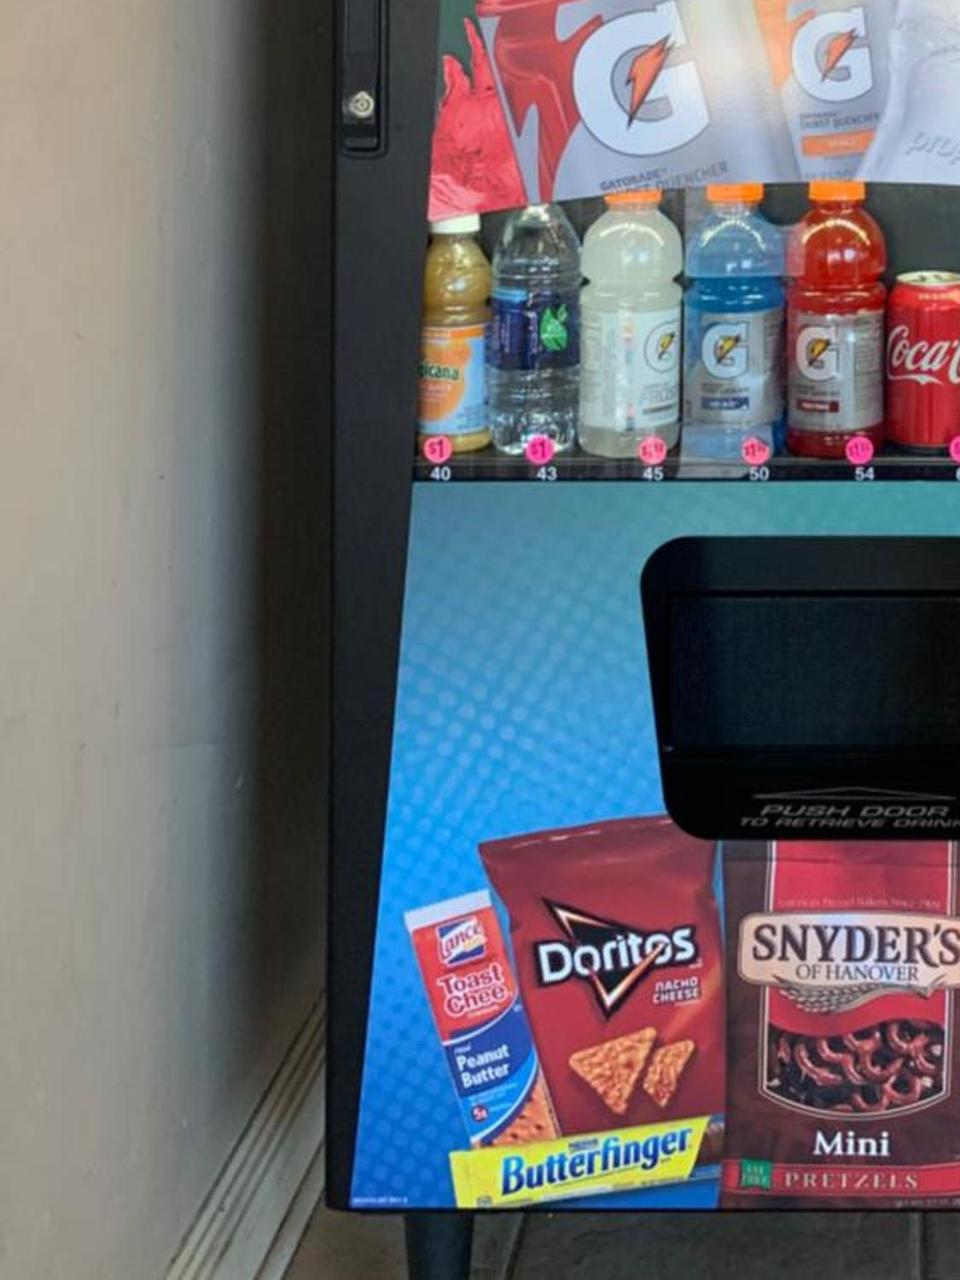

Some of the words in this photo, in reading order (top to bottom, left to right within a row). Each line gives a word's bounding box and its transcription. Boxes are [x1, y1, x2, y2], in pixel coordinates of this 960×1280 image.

[791, 8, 875, 102] G
[572, 0, 711, 156] G
[702, 322, 748, 378] G
[796, 323, 839, 381] G
[431, 467, 451, 481] 40
[536, 467, 557, 481] 43
[643, 467, 664, 481] 45
[749, 467, 770, 481] 50
[854, 466, 875, 481] 54
[739, 817, 769, 828] TO
[775, 817, 886, 829] RETRIEVE
[759, 804, 852, 818] PUSH
[859, 805, 950, 818] DOOR
[538, 927, 696, 985] Doritos
[437, 964, 502, 995] Toast
[796, 964, 823, 981] OF
[826, 964, 919, 982] HANOVER
[446, 986, 506, 1014] Chee
[653, 988, 699, 1005] CHEESE
[455, 1044, 510, 1072] Peanut
[461, 1063, 510, 1089] Butter
[813, 1130, 891, 1157] Mini
[501, 1128, 694, 1197] Butterfinger
[785, 1171, 919, 1189] PRETZELS
